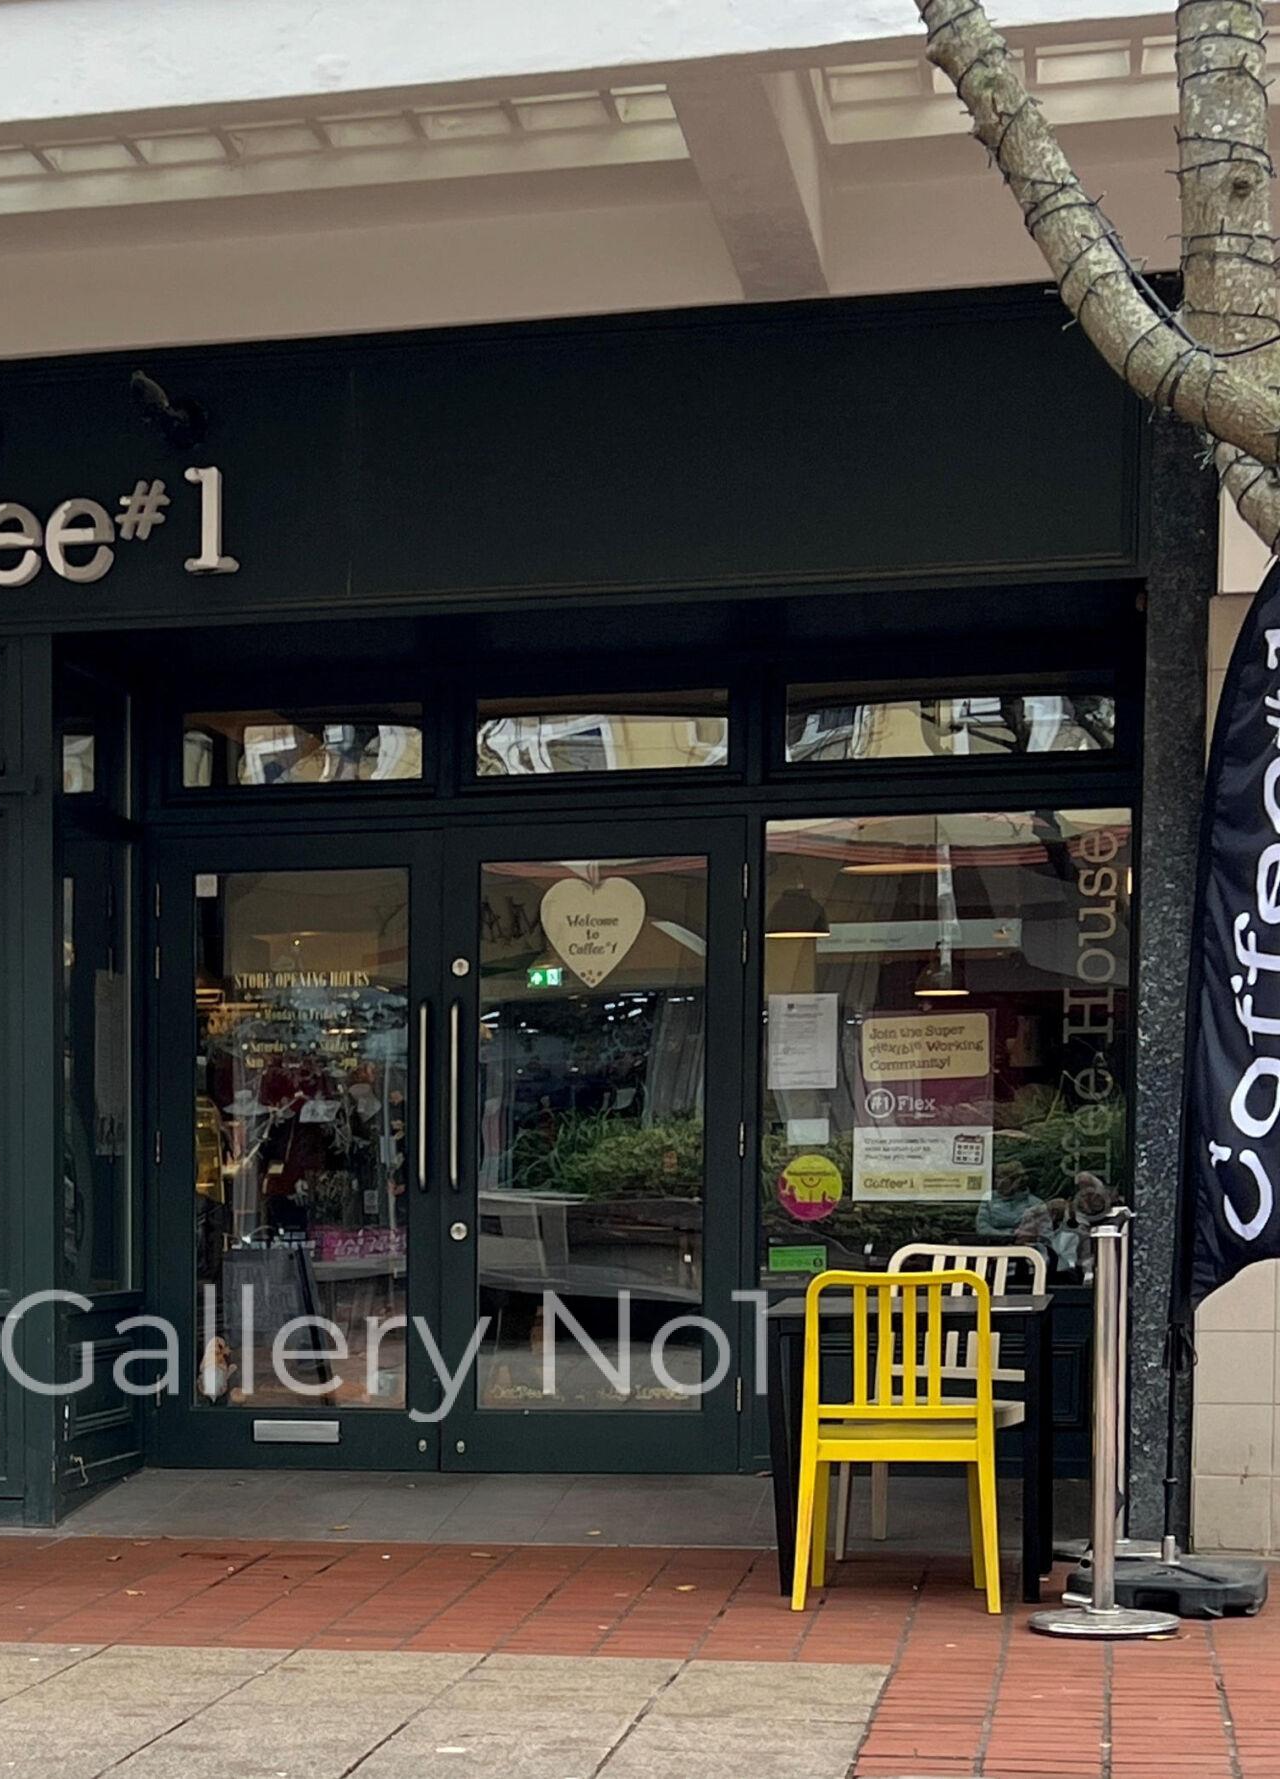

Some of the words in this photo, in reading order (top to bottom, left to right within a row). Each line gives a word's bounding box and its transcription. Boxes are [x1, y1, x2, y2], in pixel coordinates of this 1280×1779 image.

[566, 913, 619, 927] Welcome
[586, 929, 599, 940] to
[1063, 831, 1119, 1044] House
[234, 972, 271, 989] STORE
[275, 971, 327, 988] OPENING
[330, 970, 370, 987] HOURS
[869, 1027, 897, 1040] Join
[900, 1026, 922, 1038] the
[925, 1024, 965, 1039] Super
[925, 1039, 984, 1053] Working
[897, 1095, 936, 1111] Flex
